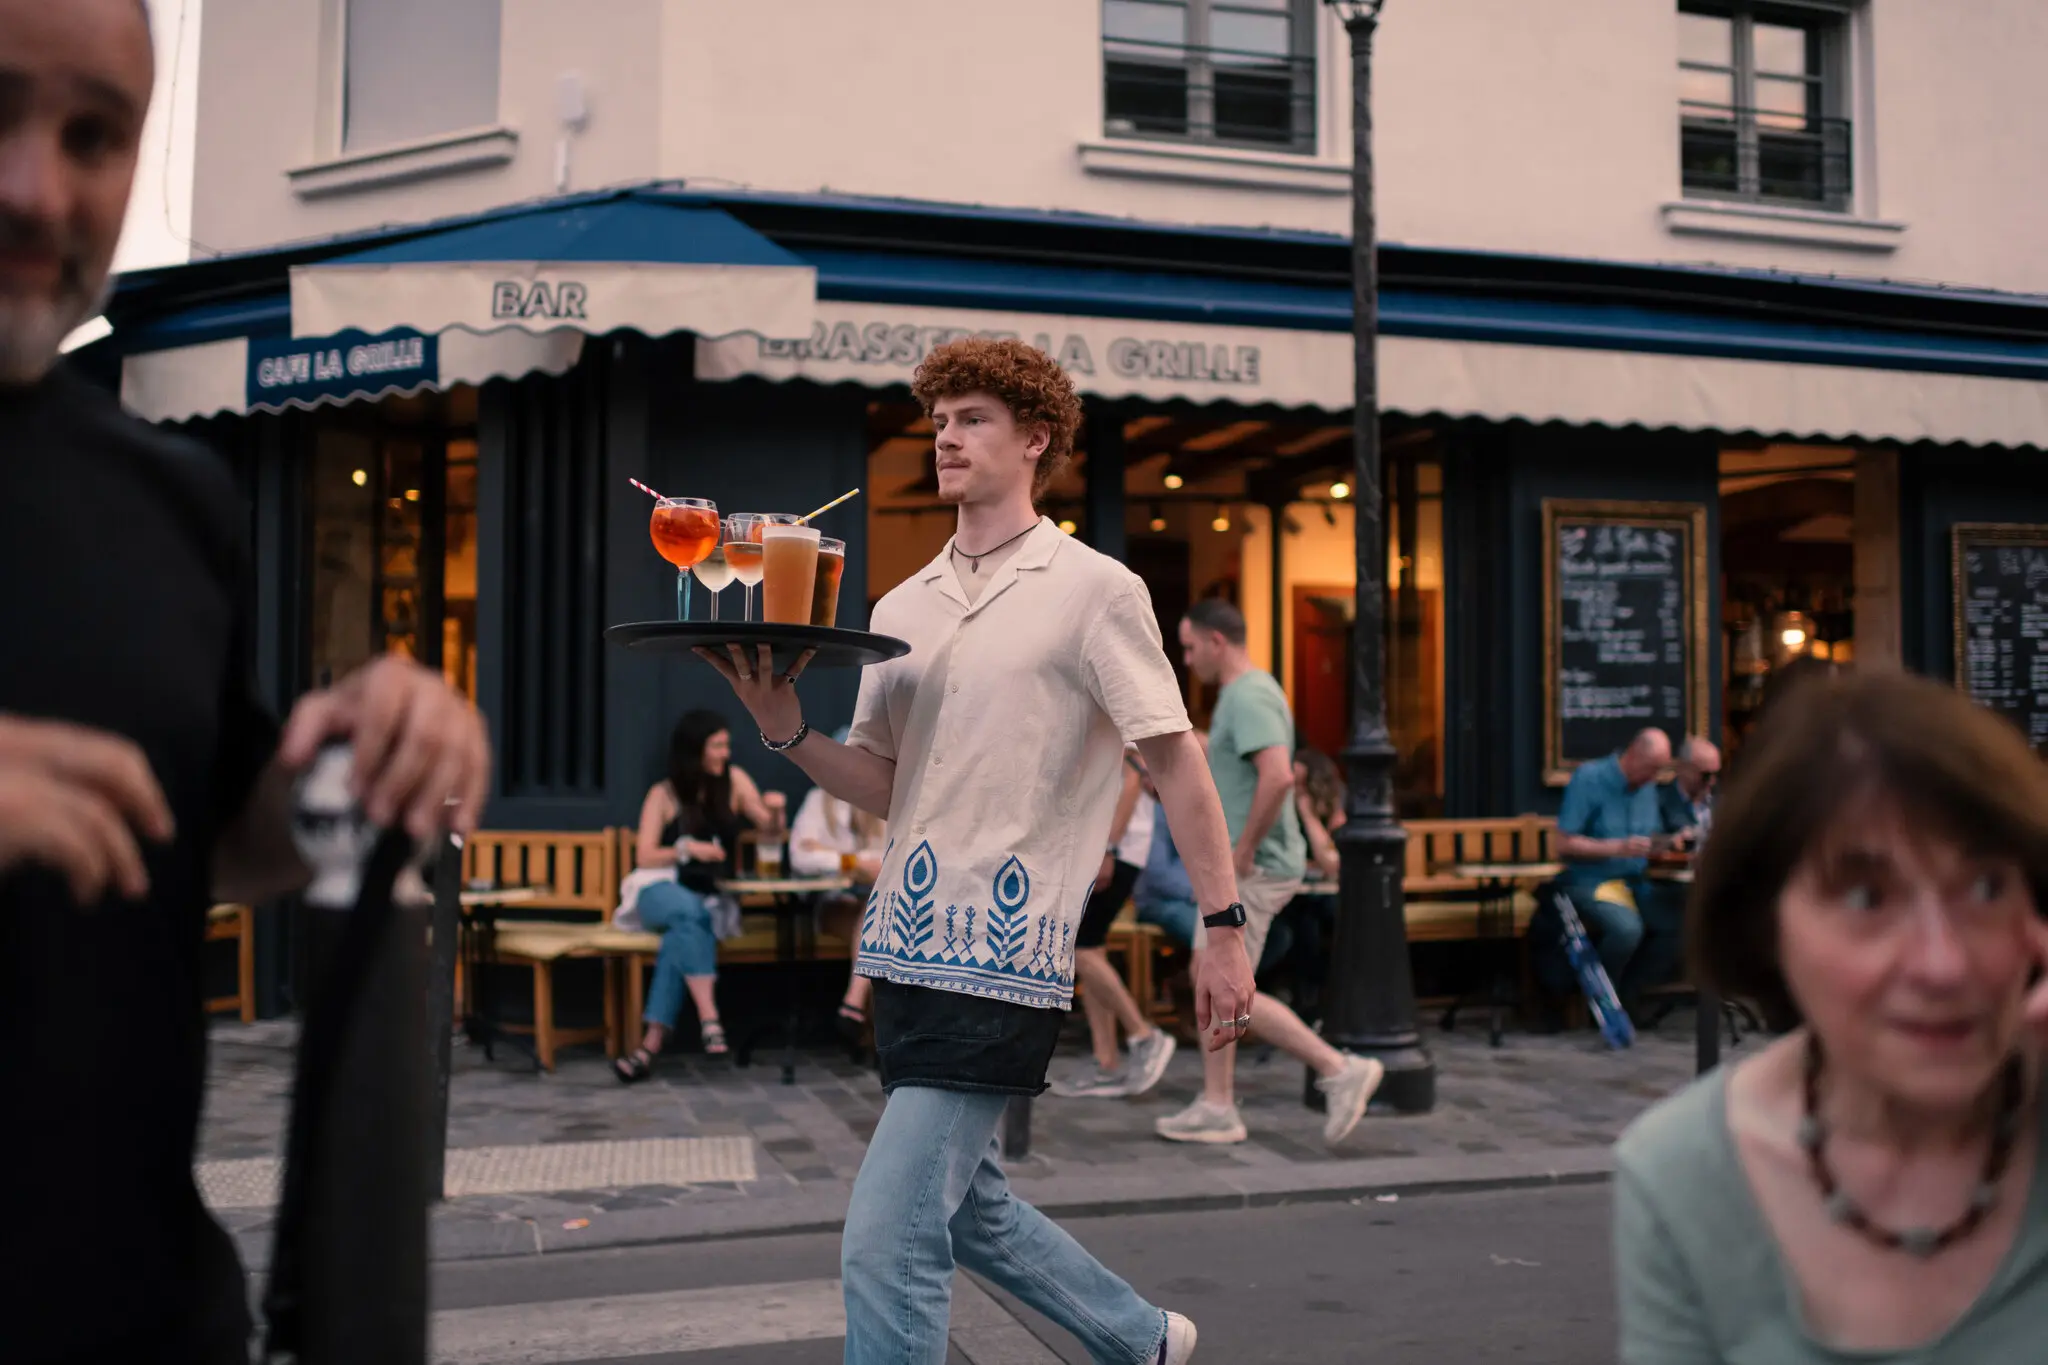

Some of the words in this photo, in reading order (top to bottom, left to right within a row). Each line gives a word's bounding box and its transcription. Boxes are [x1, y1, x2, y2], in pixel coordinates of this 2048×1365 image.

[492, 281, 588, 319] BAR
[314, 349, 344, 381] LA
[347, 337, 424, 376] GRILLE
[1106, 337, 1261, 384] GRILLE
